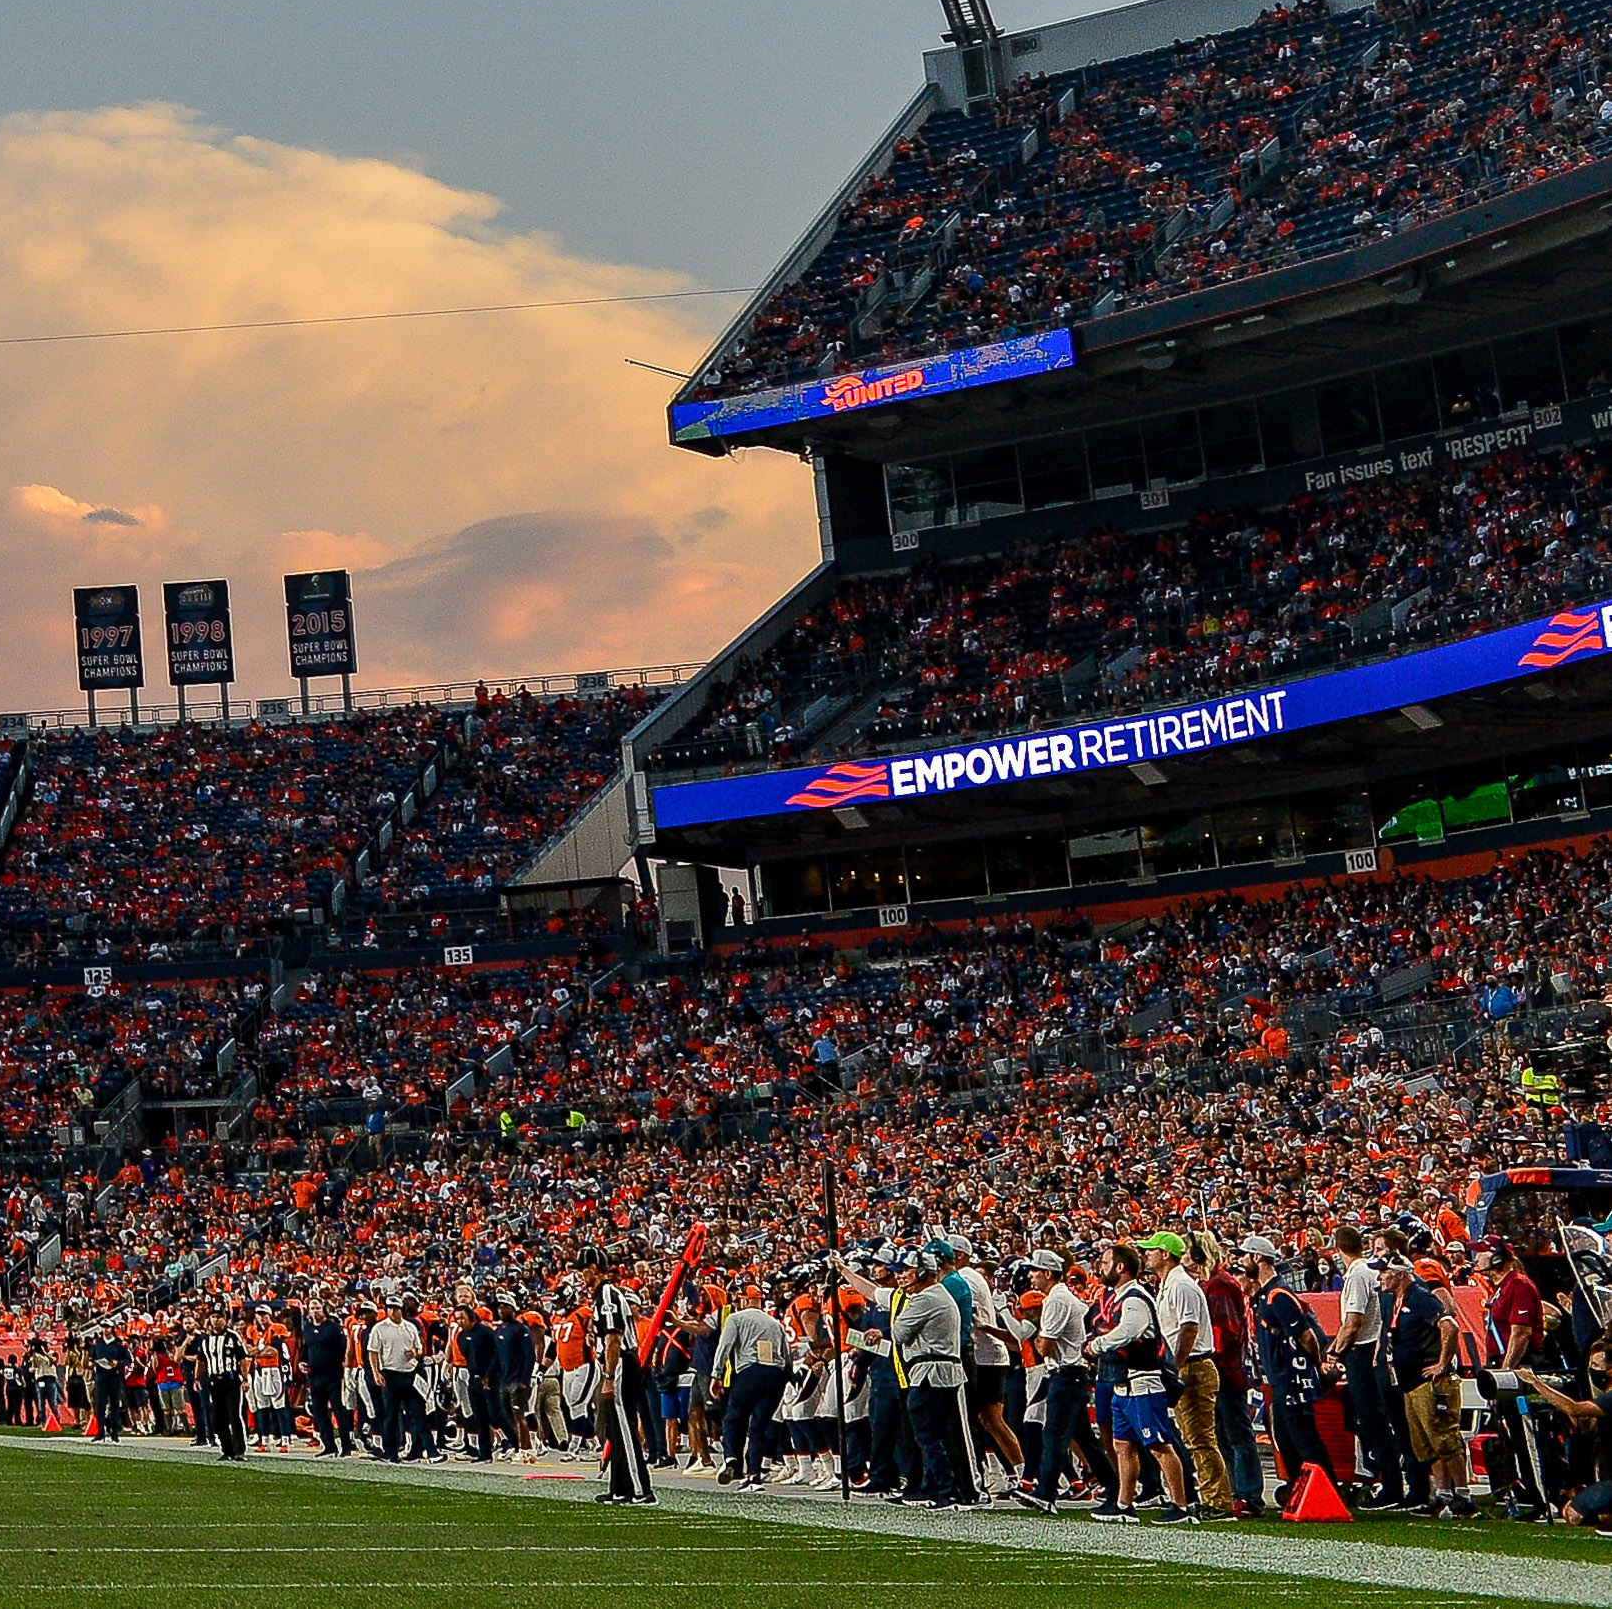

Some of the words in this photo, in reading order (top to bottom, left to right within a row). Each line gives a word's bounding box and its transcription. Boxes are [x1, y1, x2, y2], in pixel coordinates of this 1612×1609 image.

[845, 370, 923, 407] UNITED
[1305, 472, 1335, 491] Fan
[1340, 459, 1393, 484] issues
[1400, 447, 1433, 472] text
[894, 533, 918, 549] 300
[293, 610, 345, 635] 2015
[81, 626, 133, 649] 1997
[171, 621, 225, 643] 1998
[171, 651, 200, 661] SUPER
[203, 649, 229, 659] BOWL
[293, 642, 321, 654] SUPER
[325, 641, 349, 651] BOWL
[81, 655, 109, 667] SUPER
[114, 654, 139, 665] BOWL
[295, 651, 348, 666] CHAMPIONS
[84, 666, 137, 679] CHAMPIONS
[175, 661, 227, 674] CHAMPIONS
[262, 704, 283, 715] 235
[1, 717, 23, 727] 234
[891, 735, 1077, 795] EMPOWER
[1080, 691, 1286, 767] RETIREMENT
[1348, 854, 1374, 870] 100
[882, 909, 907, 924] 100
[447, 949, 471, 963] 135
[553, 1321, 574, 1343] 77
